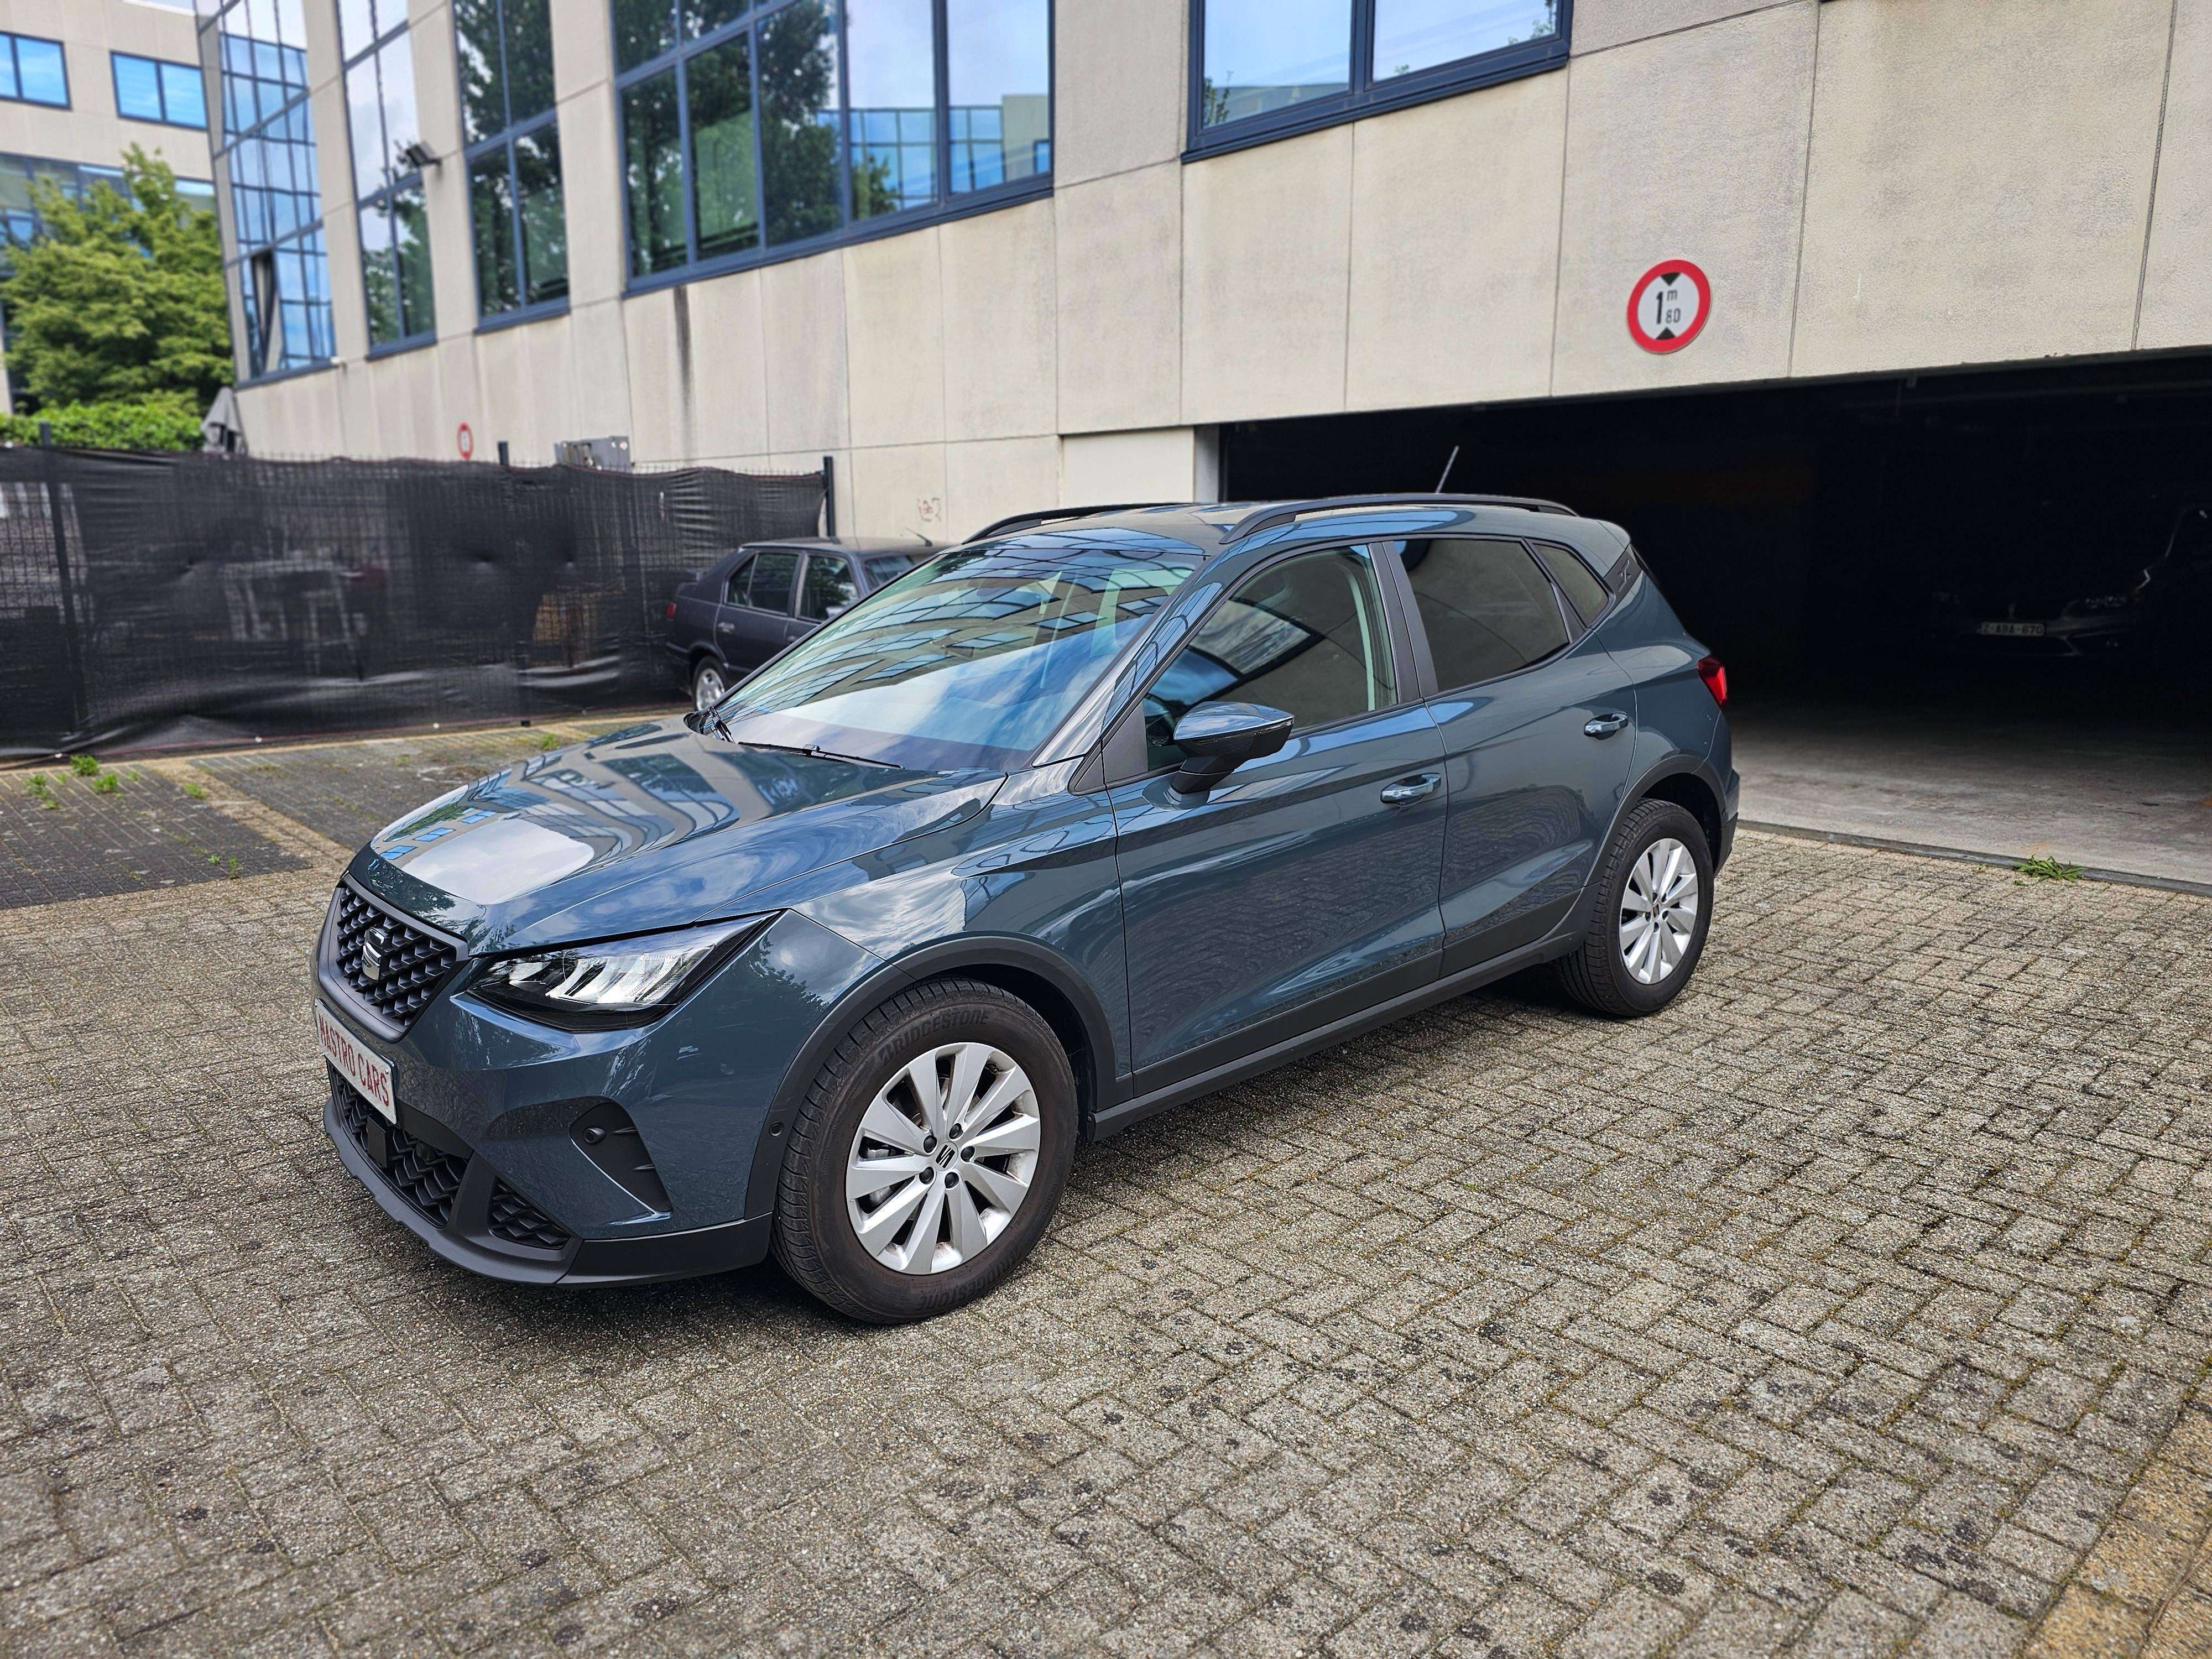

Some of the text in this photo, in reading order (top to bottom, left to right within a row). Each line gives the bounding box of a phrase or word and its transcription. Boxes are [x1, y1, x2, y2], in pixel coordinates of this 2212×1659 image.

[1656, 289, 1678, 325] 1 m
[319, 1013, 389, 1107] MASTRO CARS
